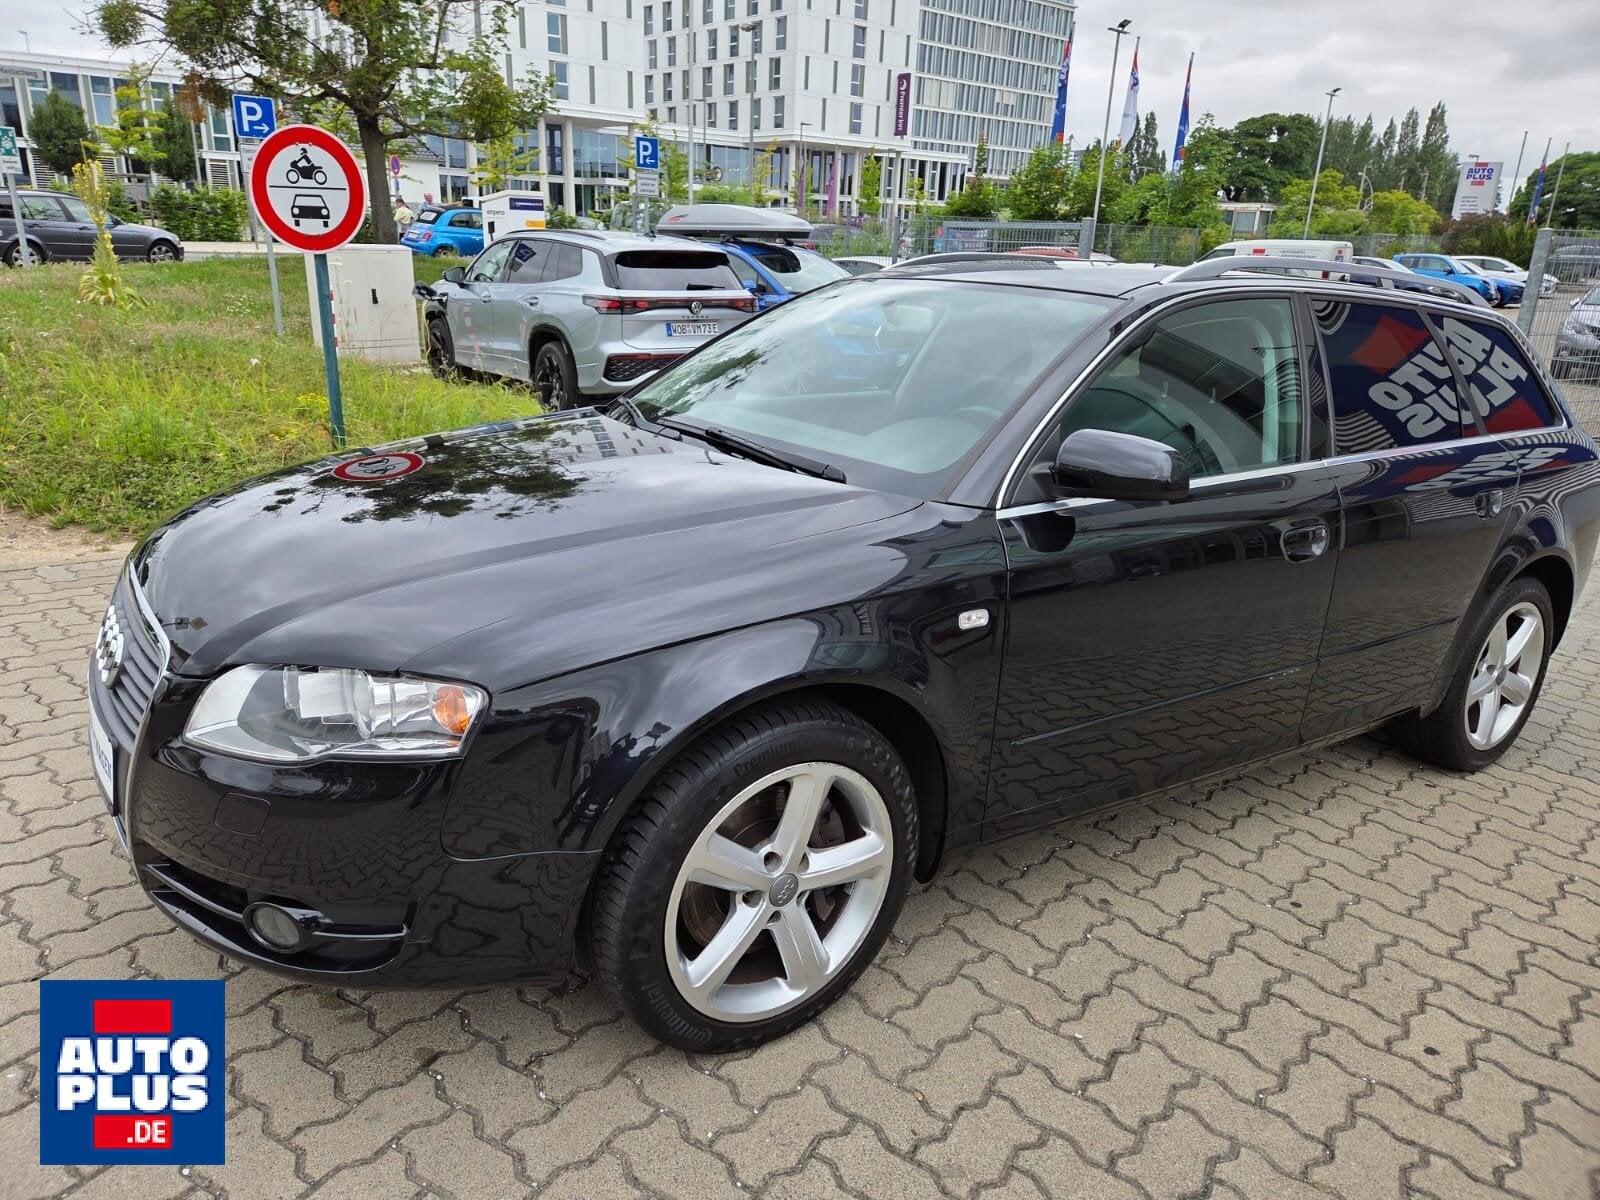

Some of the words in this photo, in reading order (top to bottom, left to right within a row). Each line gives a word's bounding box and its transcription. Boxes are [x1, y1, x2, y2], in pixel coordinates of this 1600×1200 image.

[240, 101, 262, 132] P
[639, 140, 652, 164] P
[671, 323, 687, 334] WOB
